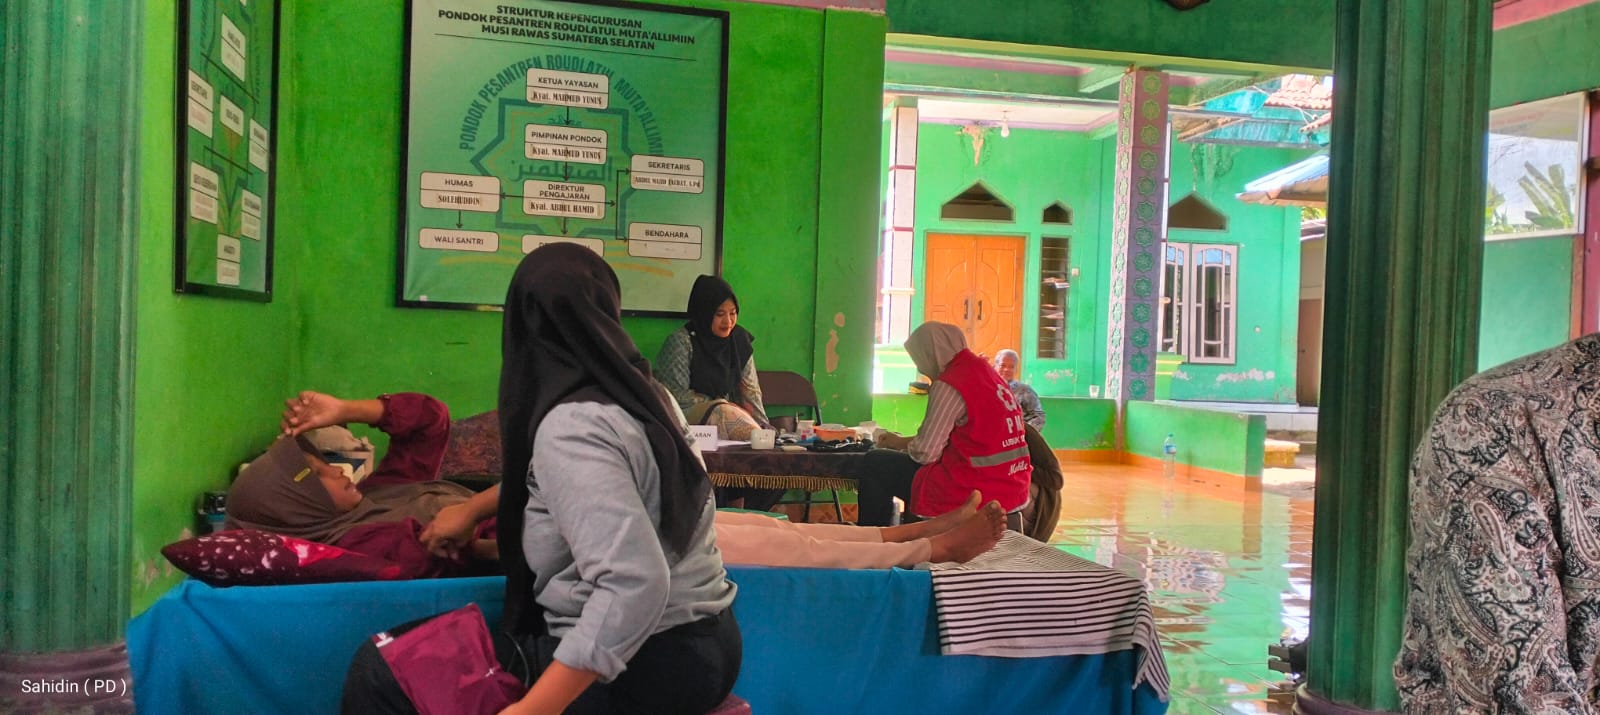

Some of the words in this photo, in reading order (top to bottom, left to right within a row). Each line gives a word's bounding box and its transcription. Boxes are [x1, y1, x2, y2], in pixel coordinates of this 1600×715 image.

[496, 5, 555, 20] STRUKTUR
[556, 11, 642, 29] KEPENGURUSAN
[438, 9, 488, 23] PONDOK
[489, 15, 552, 30] PESANTREN
[553, 21, 617, 37] ROUDLATUL
[618, 28, 695, 45] MUTA'ALLIMIIN
[481, 24, 509, 36] MUSI
[511, 27, 550, 40] RAWAS
[551, 32, 608, 46] SUMATERA
[610, 39, 655, 51] SELATAN
[537, 76, 563, 85] KETUA
[564, 79, 599, 89] YAYASAN
[459, 99, 488, 151] PONDOK
[531, 131, 569, 141] PIMPINAN
[570, 134, 602, 144] PONDOK
[647, 161, 691, 171] SEKRETARIS
[444, 179, 474, 188] HUMAS
[539, 190, 590, 201] PENGAJARAN
[434, 235, 454, 244] WALI
[455, 236, 485, 246] SANTRI
[644, 229, 689, 239] BENDAHARA
